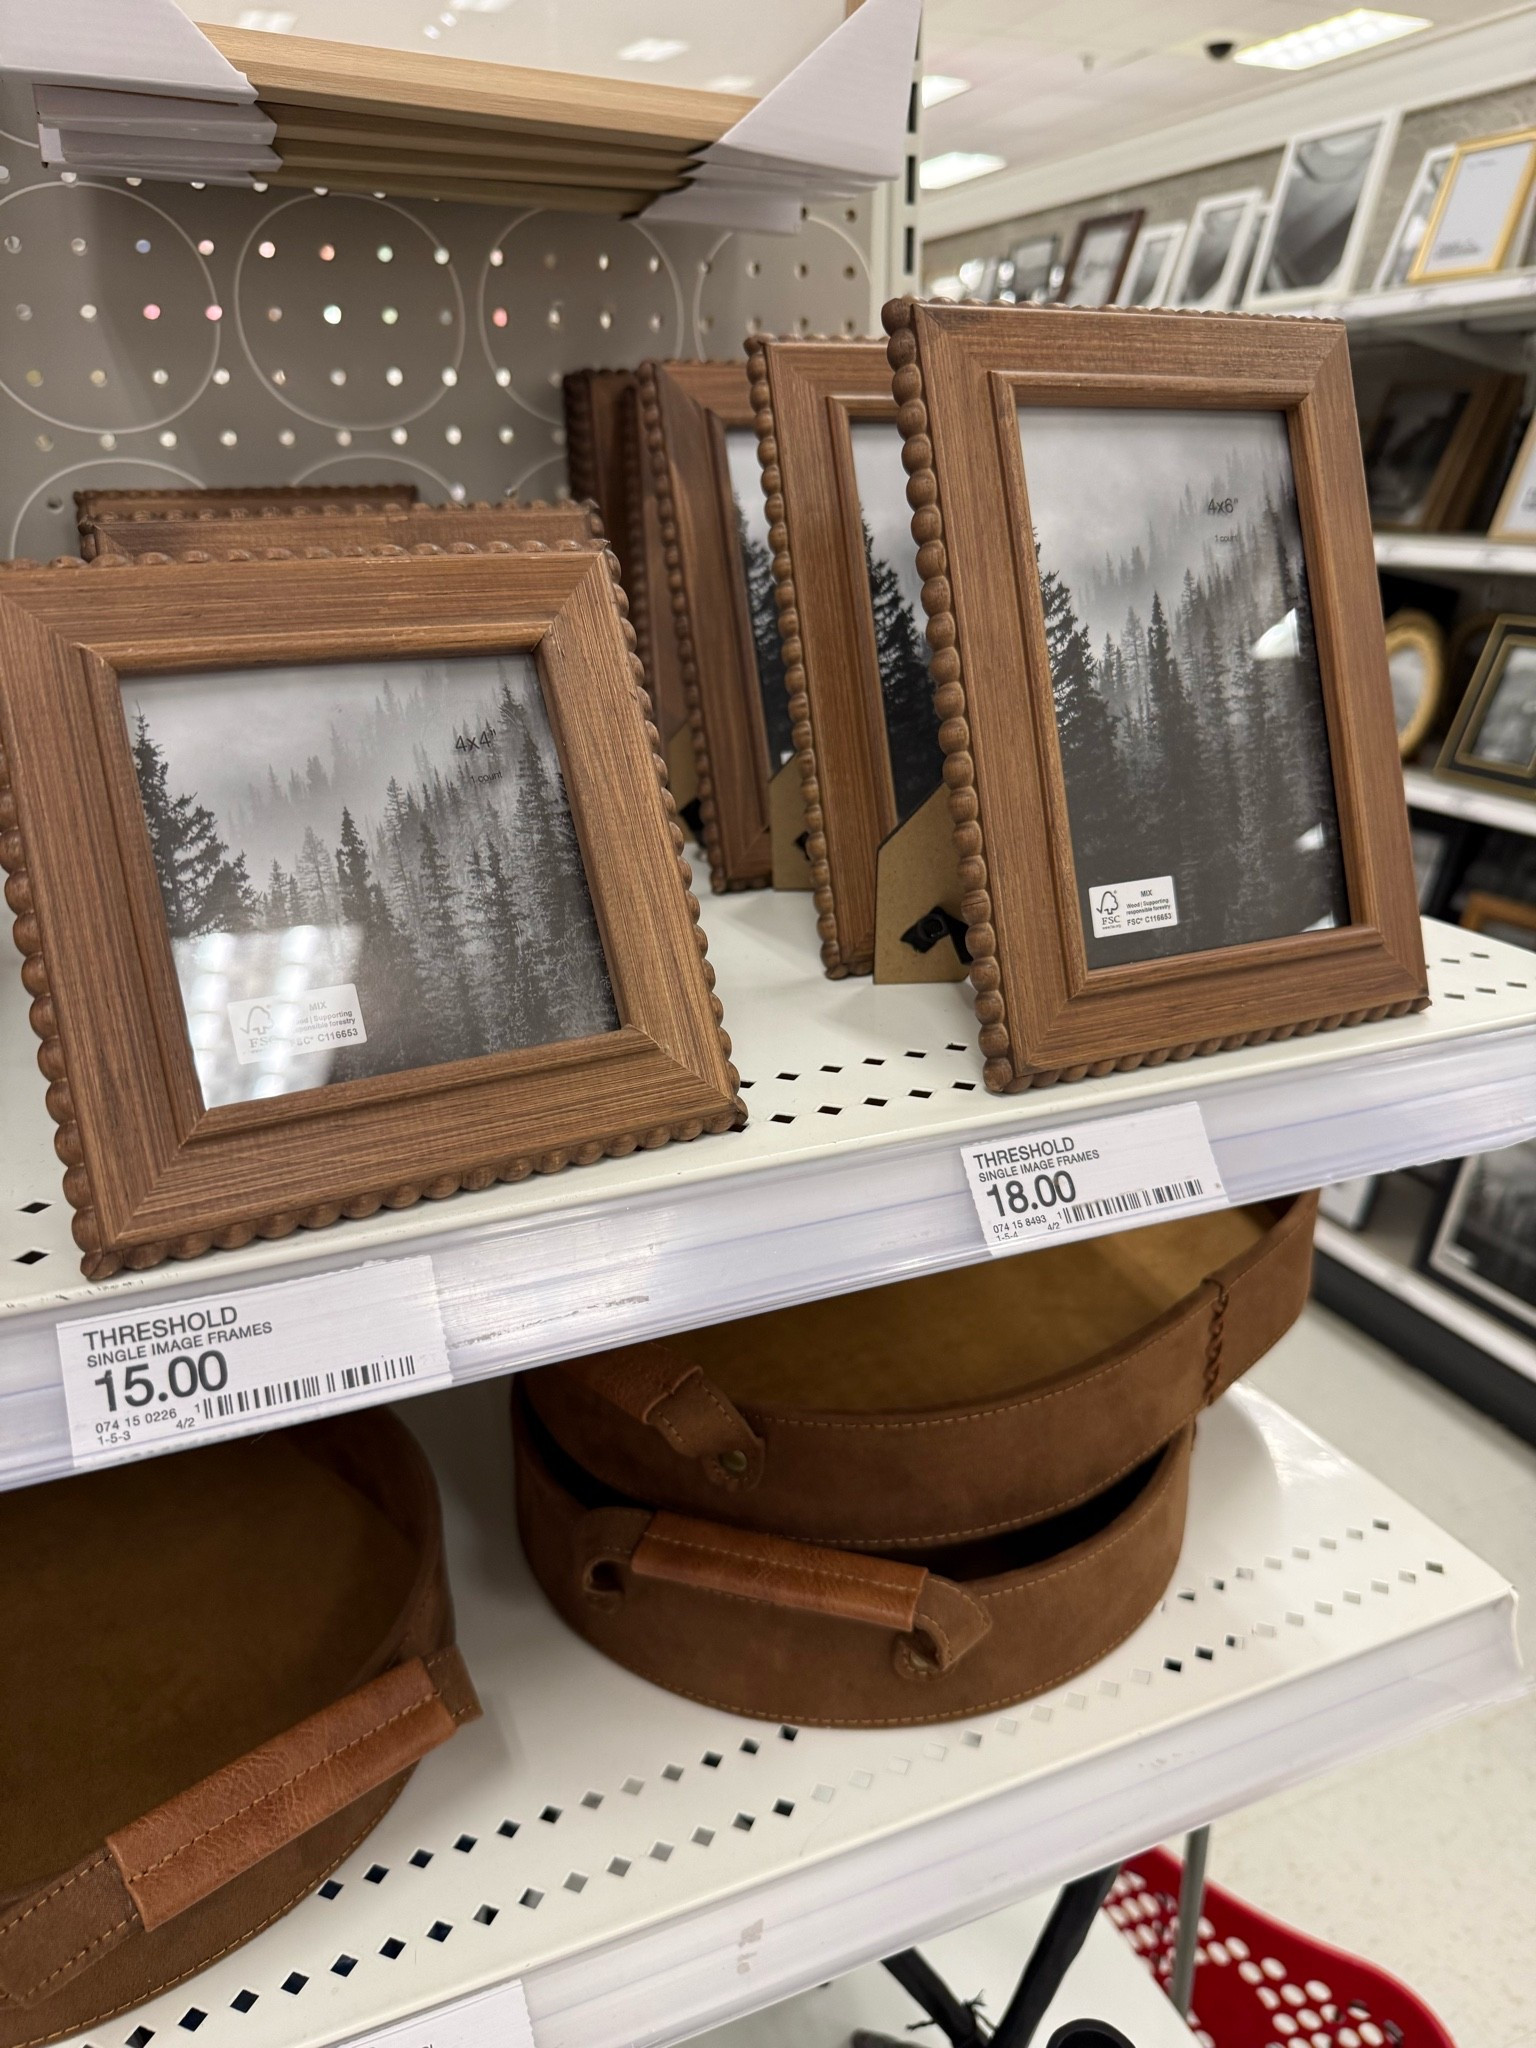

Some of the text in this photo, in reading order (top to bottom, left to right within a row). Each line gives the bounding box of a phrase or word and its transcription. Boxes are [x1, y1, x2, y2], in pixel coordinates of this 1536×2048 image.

[1140, 889, 1153, 897] MIX
[1142, 898, 1169, 907] Supporting
[1126, 904, 1171, 915] responsible forestry
[1101, 915, 1120, 925] FSC
[309, 1001, 327, 1011] MIX
[313, 1010, 353, 1022] Supporting
[329, 1017, 356, 1028] forestry
[317, 1028, 359, 1042] C116653
[973, 1136, 1075, 1170] THRESHOLD
[978, 1149, 1100, 1183] SINGLE IMAGE FRAMES
[986, 1170, 1077, 1217] 18.00
[1057, 1211, 1062, 1220] 1
[993, 1214, 1047, 1234] 074 15 8493
[1047, 1221, 1060, 1232] 4/2
[996, 1231, 1019, 1241] 1-5-4
[83, 1305, 238, 1351] THRESHOLD
[87, 1321, 273, 1368] SINGLE IMAGE FRAMES
[95, 1349, 229, 1412] 15.00
[194, 1403, 200, 1414] 1
[95, 1408, 177, 1434] 074 15 0226
[176, 1416, 195, 1431] 4/2
[97, 1430, 131, 1445] 1-5-3
